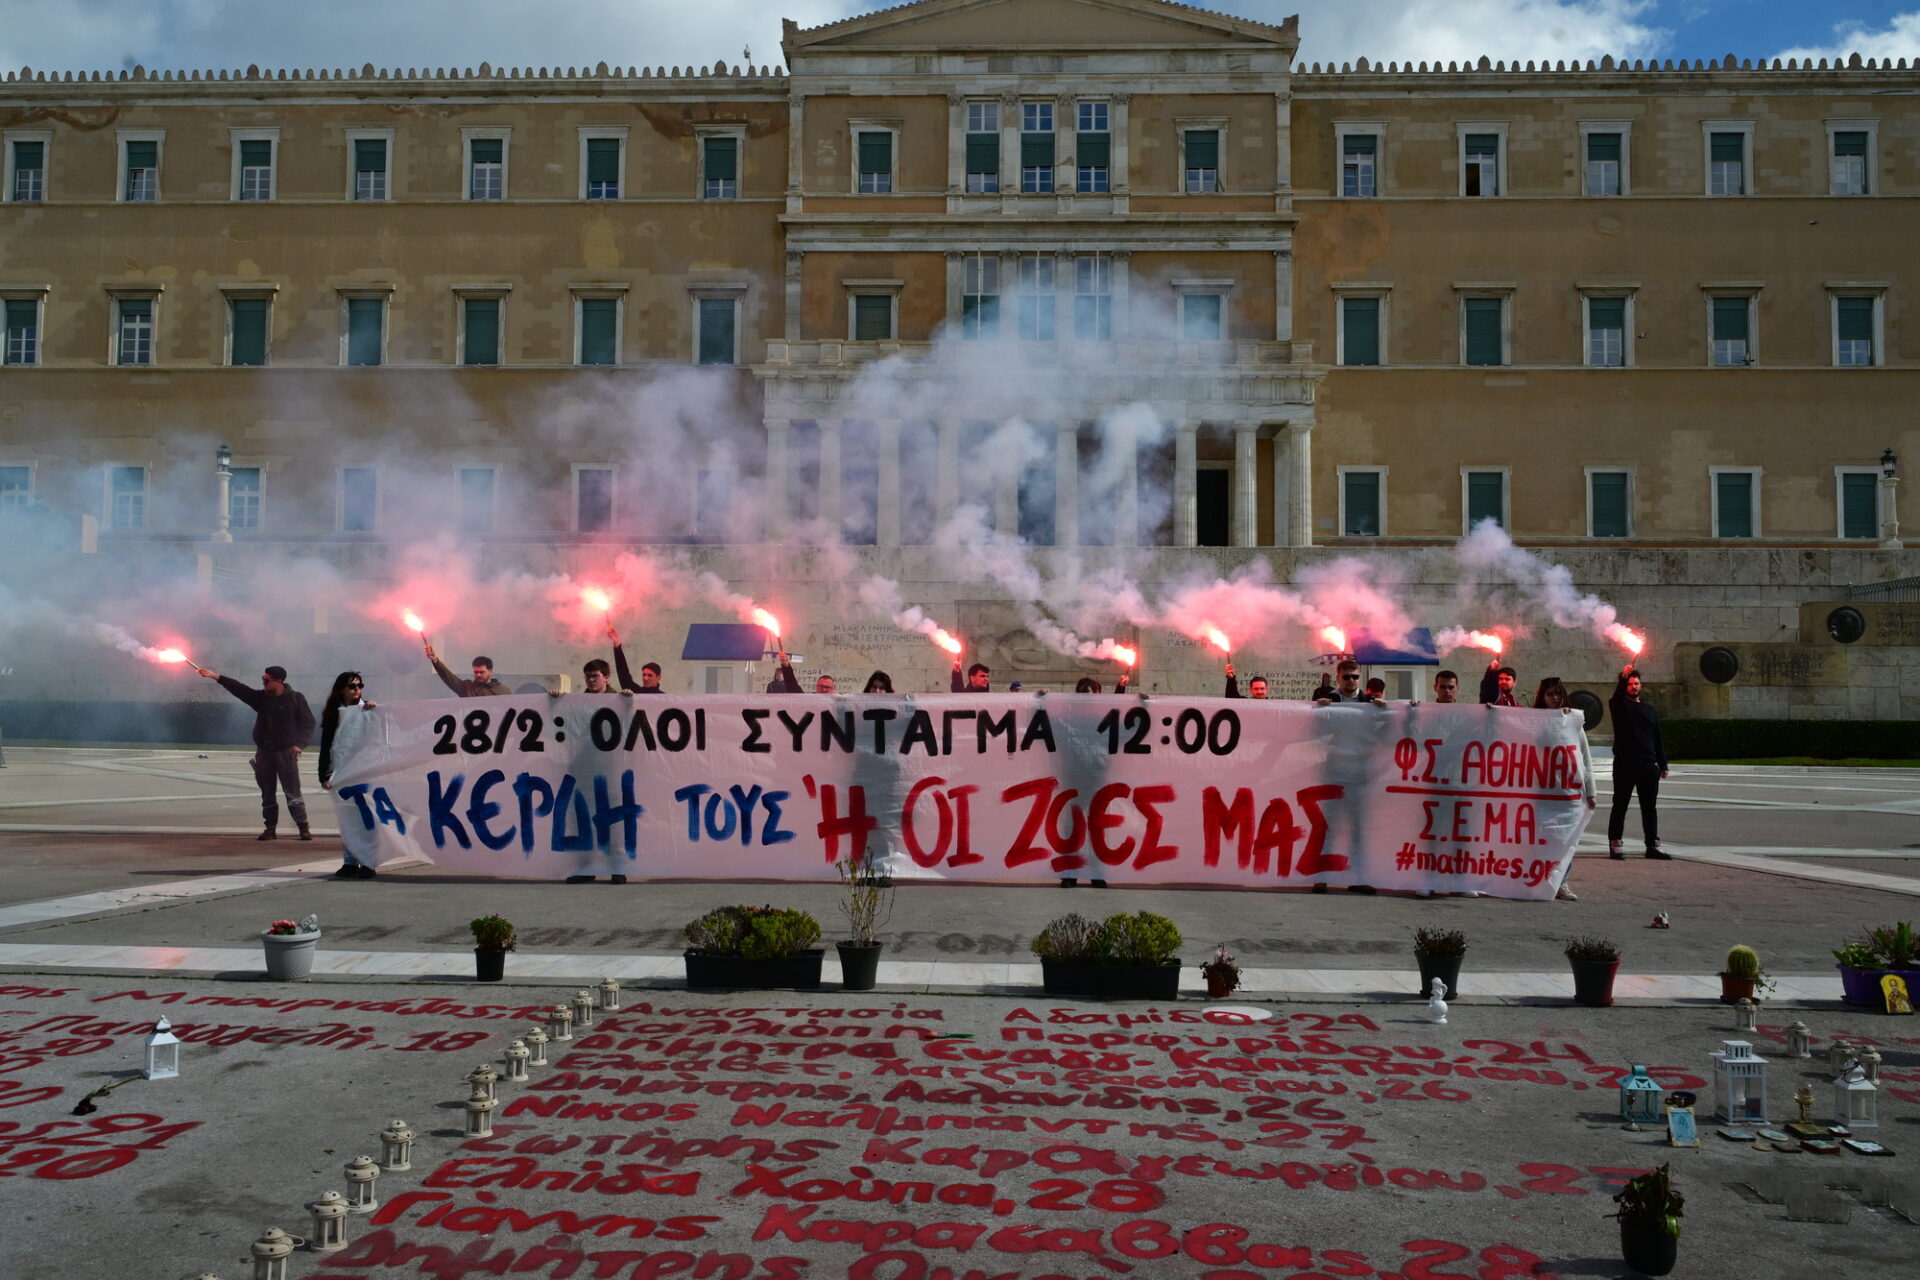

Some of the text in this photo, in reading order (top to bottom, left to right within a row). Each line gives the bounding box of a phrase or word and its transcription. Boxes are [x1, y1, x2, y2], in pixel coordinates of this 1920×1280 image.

[432, 707, 1241, 756] 28/2: ΟΛΟΙ ΣΥΝΤΑΓΜΑ 12:00
[1394, 737, 1583, 789] Φ.Σ. ΑΘΗΝΑΣ
[338, 783, 406, 836] ΤΑ
[427, 769, 645, 860] ΚΕΡΔΗ
[674, 783, 797, 846] ΤΟΥΣ
[902, 775, 984, 868] ΟΙ
[1202, 784, 1352, 877] ΜΑΣ
[1419, 800, 1547, 846] Σ.Ε.Μ.Α.
[1396, 842, 1561, 888] #mathites.gr
[394, 1031, 491, 1051] 18
[1462, 1039, 1597, 1065] 24
[1245, 1096, 1347, 1121] 26
[1249, 1121, 1377, 1150] 27
[1026, 1178, 1167, 1212] 28
